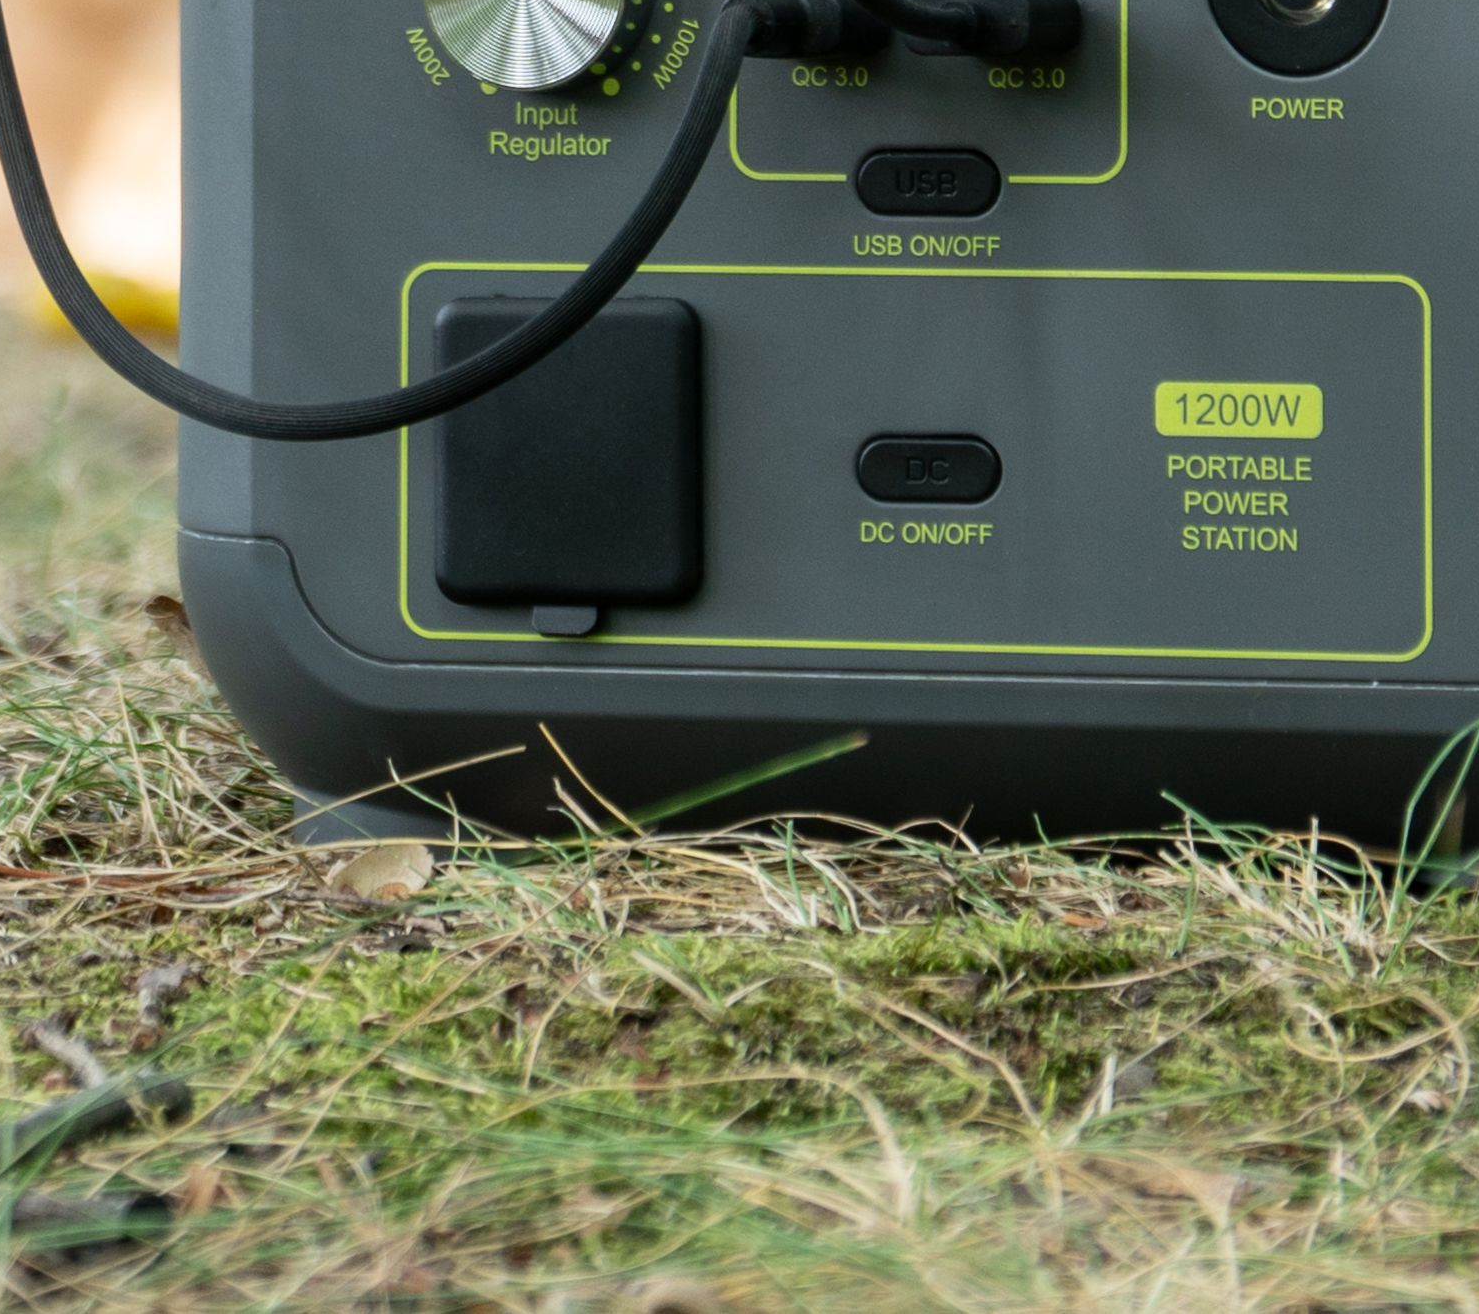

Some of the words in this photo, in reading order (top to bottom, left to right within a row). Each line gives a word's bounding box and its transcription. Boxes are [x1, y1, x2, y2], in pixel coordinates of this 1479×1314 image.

[405, 27, 451, 87] 200W
[652, 18, 700, 91] 1000W
[791, 65, 827, 88] QC
[834, 67, 868, 88] 3.0
[987, 68, 1024, 90] QC
[1031, 68, 1066, 90] 3.0
[515, 101, 579, 131] Input
[1250, 95, 1344, 121] POWER
[488, 131, 612, 162] Regulator
[895, 170, 958, 198] USB
[852, 234, 904, 257] USB
[909, 234, 1001, 258] ON/OFF
[1175, 392, 1302, 428] 1200W
[905, 456, 951, 486] DC
[1166, 454, 1313, 482] PORTABLE
[1183, 489, 1289, 517] POWER
[859, 520, 896, 544] DC
[900, 521, 994, 546] ON/OFF
[1181, 525, 1299, 552] STATION
